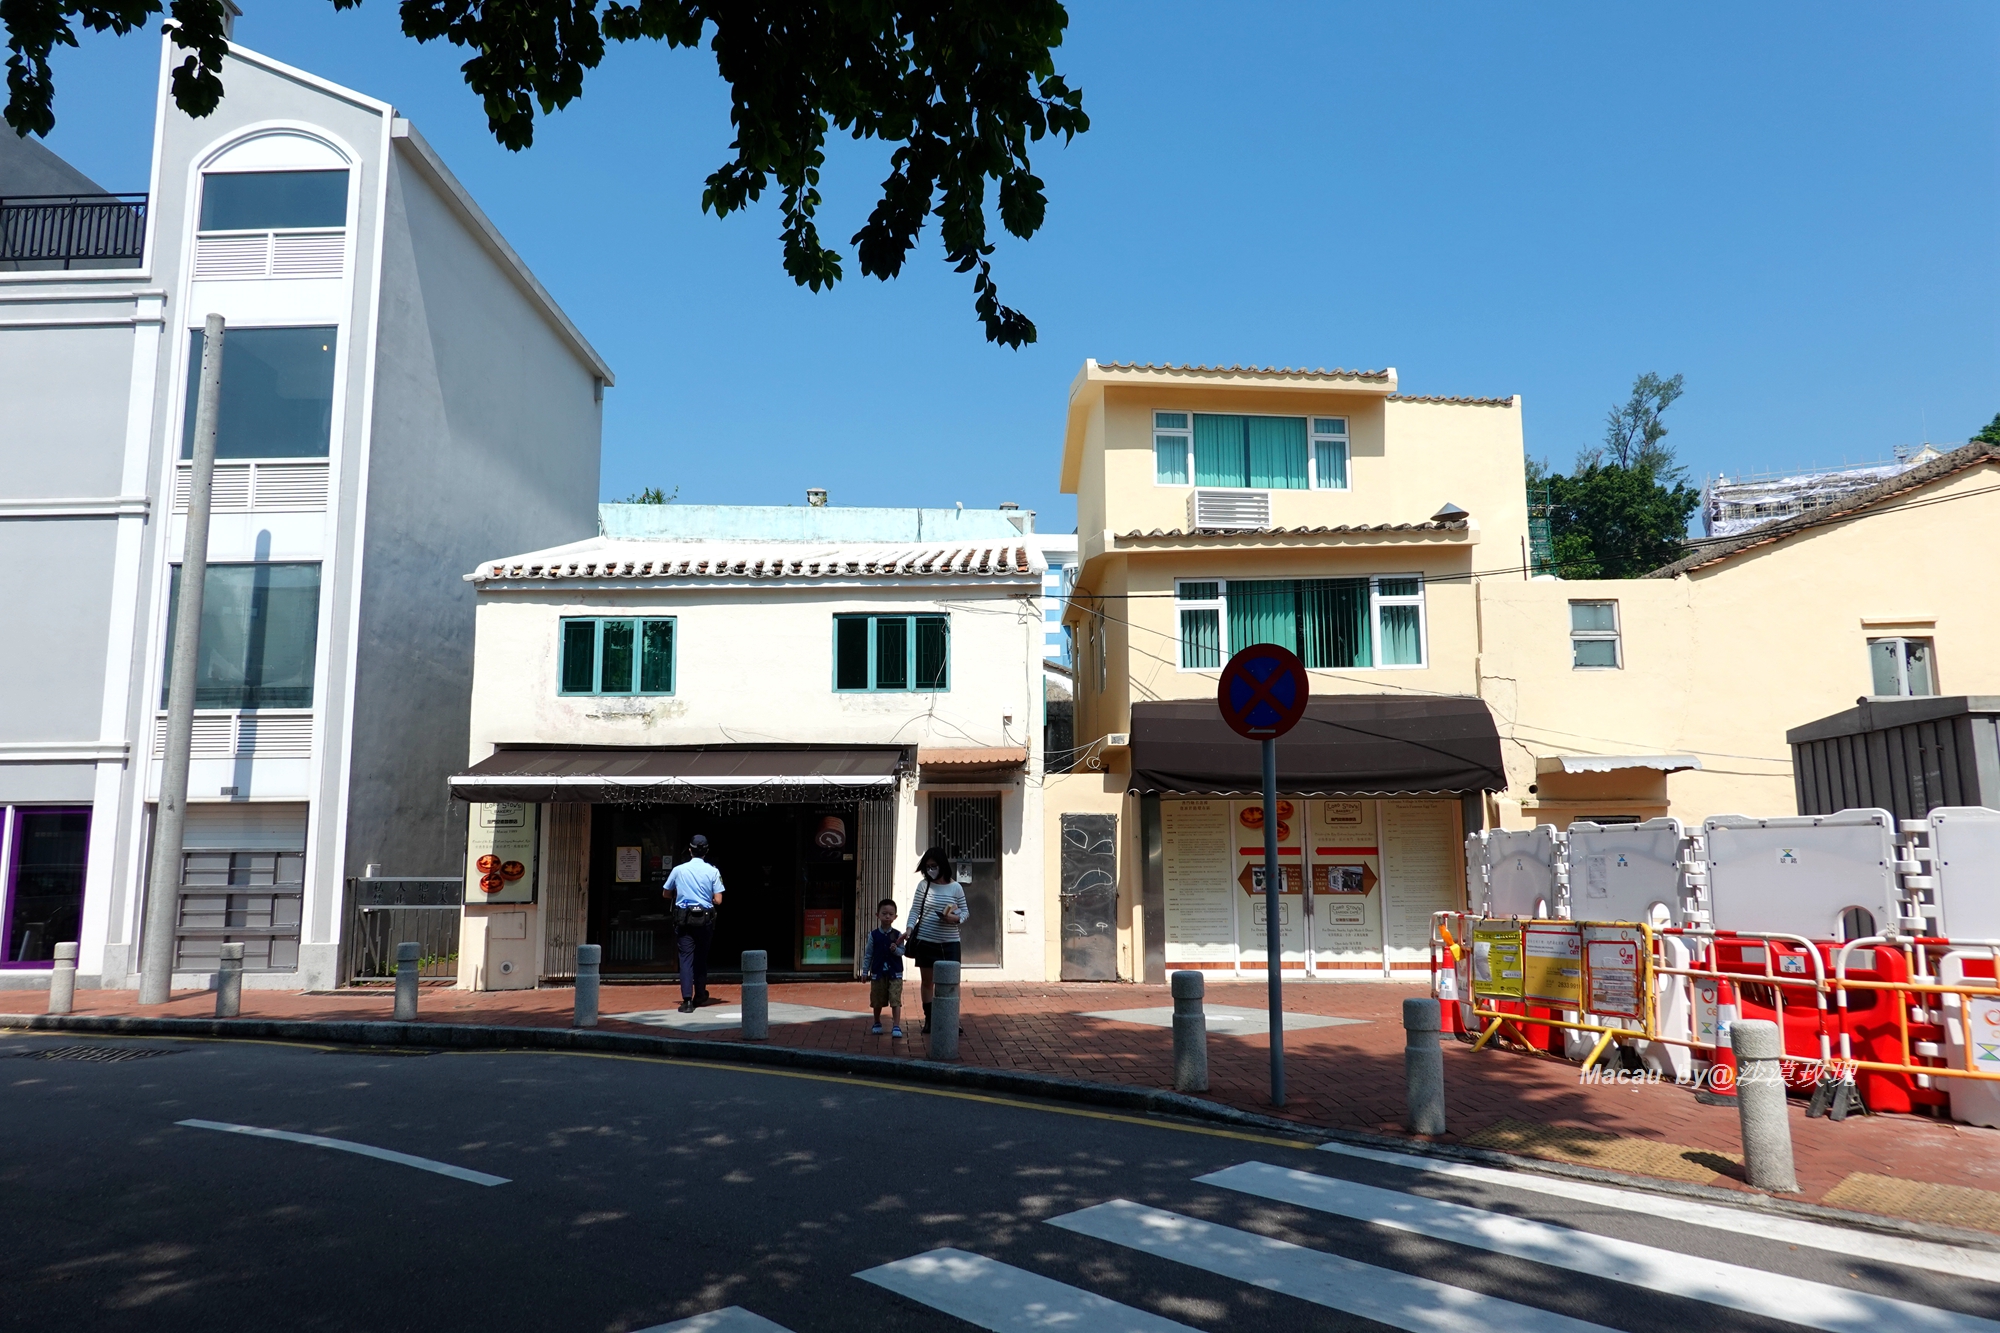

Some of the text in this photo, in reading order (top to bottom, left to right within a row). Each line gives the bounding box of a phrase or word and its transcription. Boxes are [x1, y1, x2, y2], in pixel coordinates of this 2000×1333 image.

[373, 881, 449, 893] 私人地方
[1706, 1007, 1717, 1016] ce
